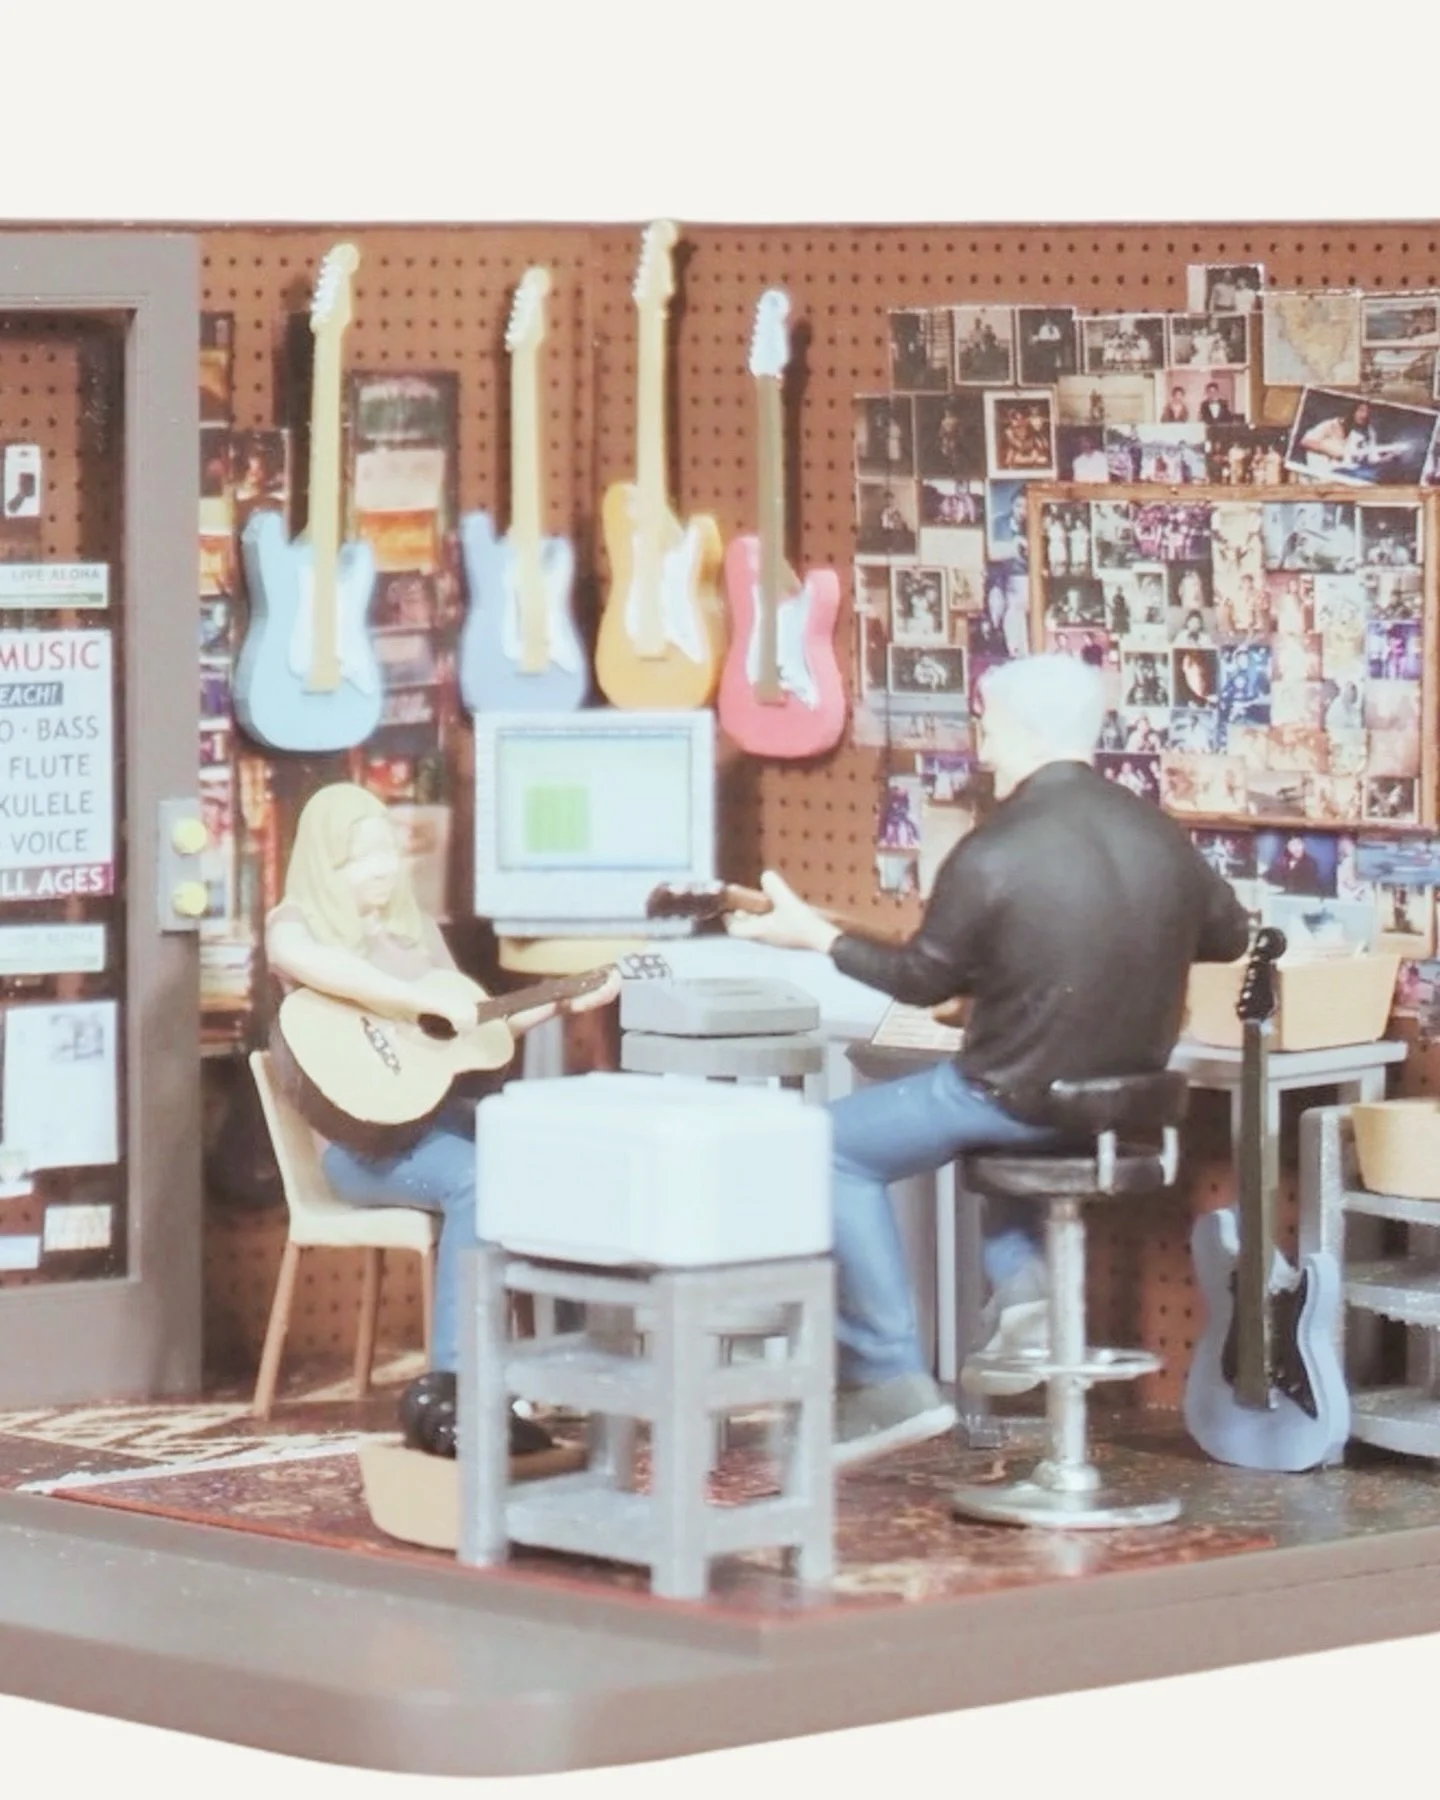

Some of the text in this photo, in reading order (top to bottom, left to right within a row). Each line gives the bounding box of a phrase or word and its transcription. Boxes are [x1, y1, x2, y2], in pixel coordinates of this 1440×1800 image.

[12, 567, 100, 581] LIVE ALOHA
[0, 640, 100, 672] MUSIC
[37, 715, 99, 741] BASS
[9, 754, 91, 781] FLUTE
[10, 829, 88, 854] VOICE
[36, 866, 104, 895] AGES
